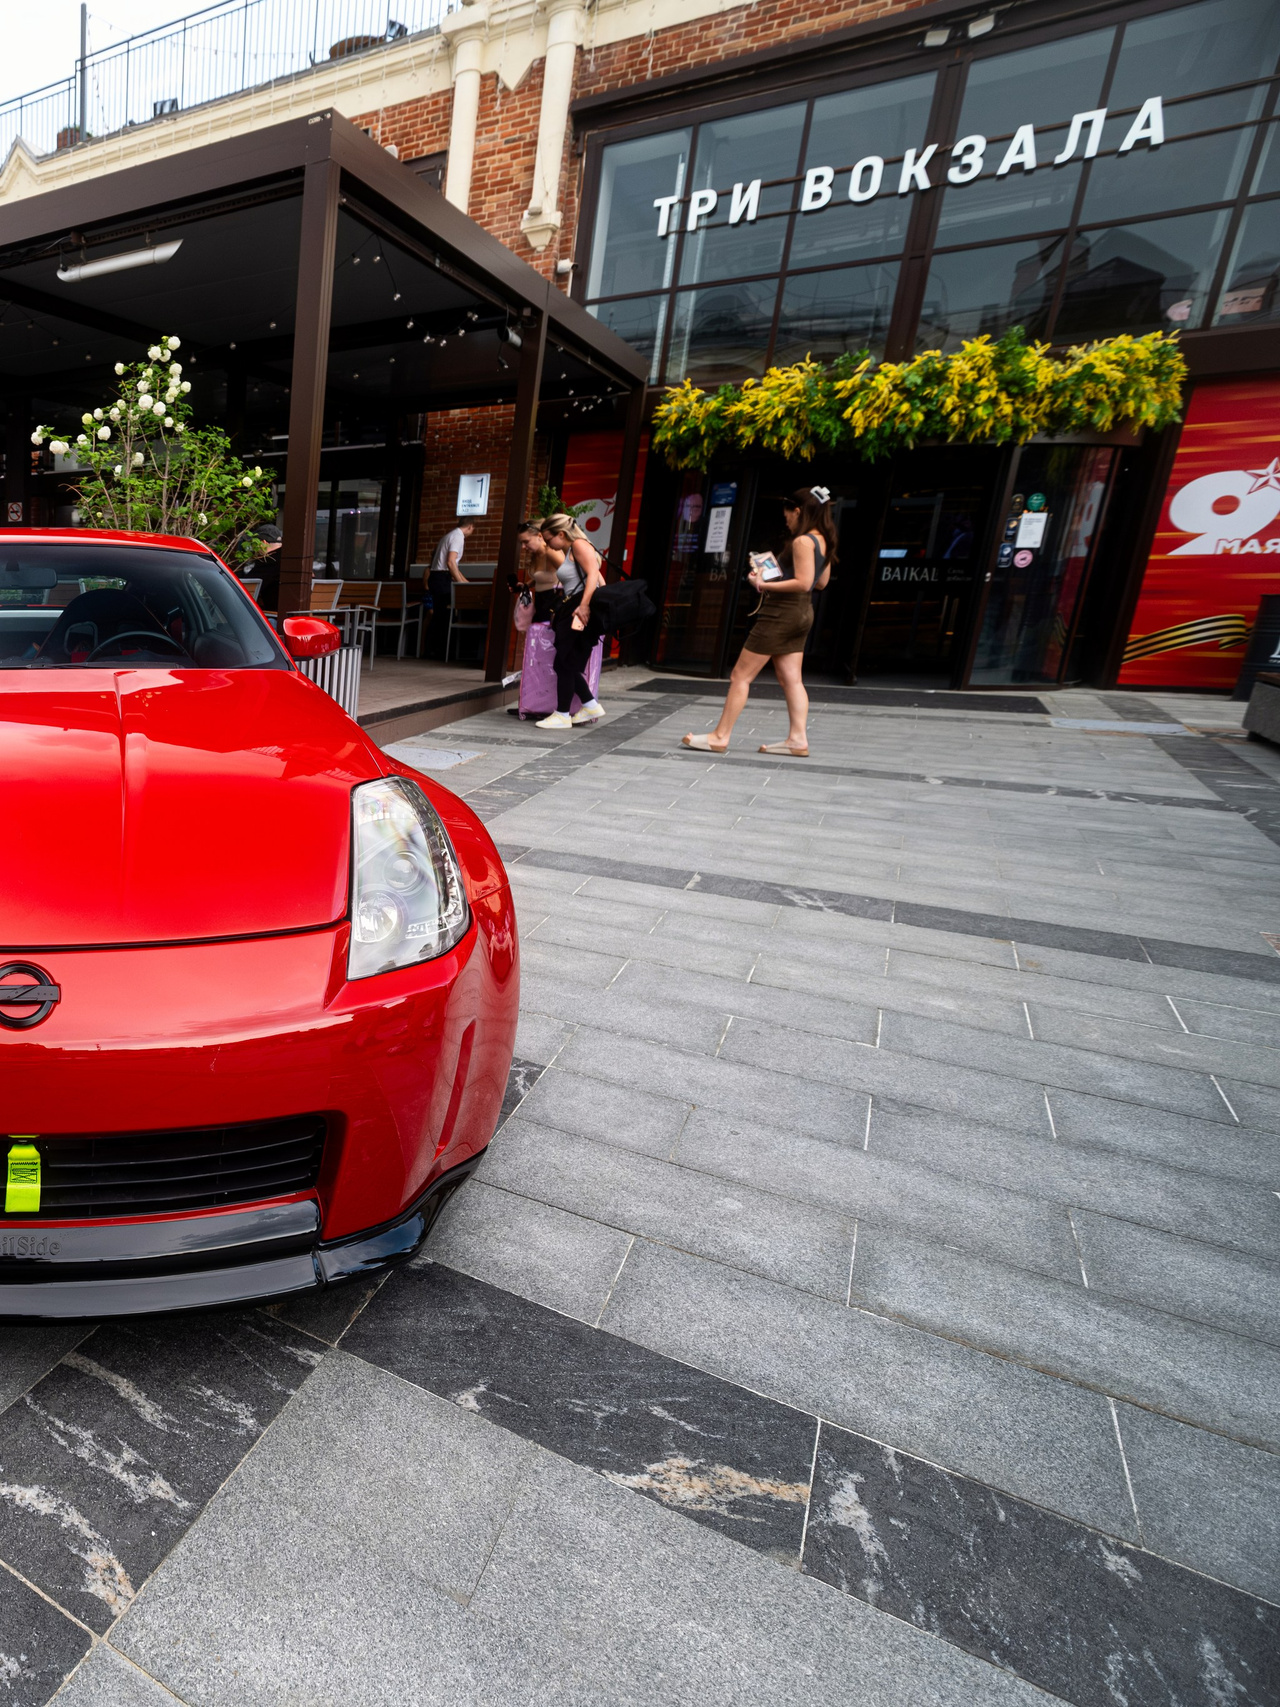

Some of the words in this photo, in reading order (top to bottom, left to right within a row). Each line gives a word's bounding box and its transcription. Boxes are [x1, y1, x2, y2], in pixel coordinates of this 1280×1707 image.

[653, 179, 762, 237] ТРИ
[800, 96, 1166, 212] ВОКЗАЛА
[1166, 469, 1280, 556] 9
[1215, 538, 1280, 555] МАЯ
[881, 566, 939, 582] BAIKAL
